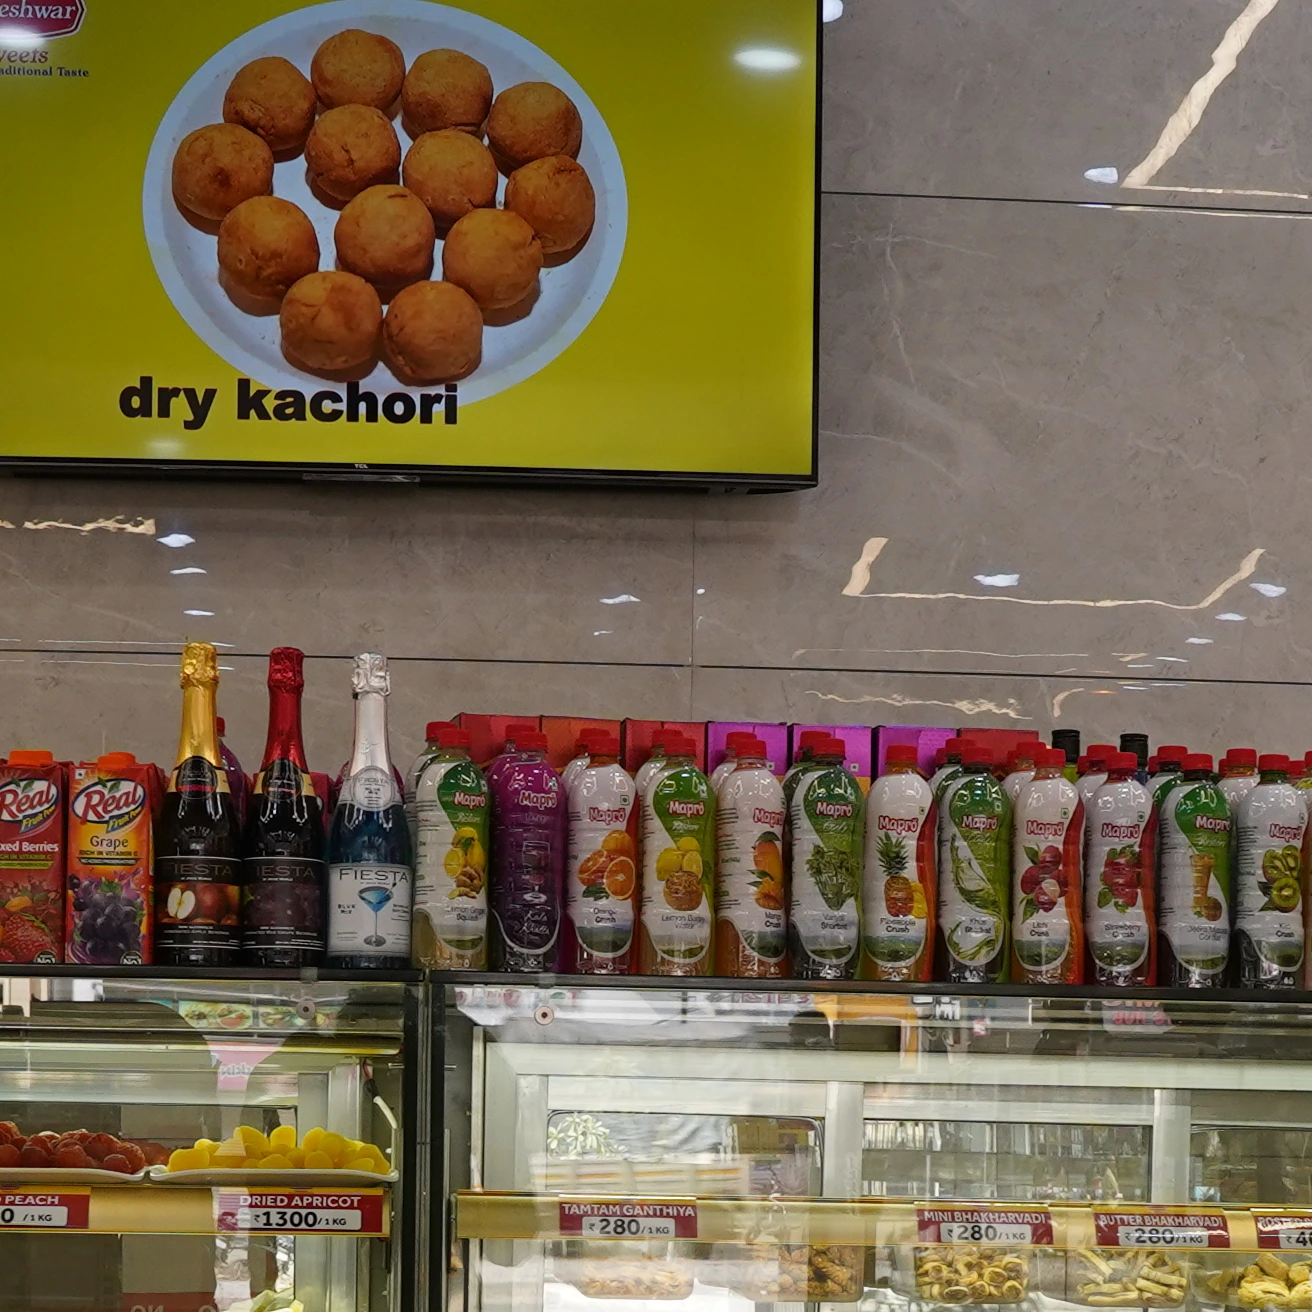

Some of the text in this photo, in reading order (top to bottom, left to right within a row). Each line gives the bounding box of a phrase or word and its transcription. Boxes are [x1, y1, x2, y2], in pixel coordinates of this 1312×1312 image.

[56, 66, 90, 77] Taste
[119, 376, 458, 430] dry kachori
[80, 781, 142, 825] Real
[21, 841, 59, 853] Berries
[90, 835, 129, 848] Grape
[339, 867, 410, 883] FIESTA
[5, 1195, 59, 1205] PEACH
[239, 1195, 362, 1207] DRIED APRICOT
[562, 1203, 695, 1217] TAMTAM GANTHIYA
[924, 1211, 1046, 1224] MINI BHAKHARVADI
[1099, 1214, 1224, 1227] BUTTER BHAKHARVADI
